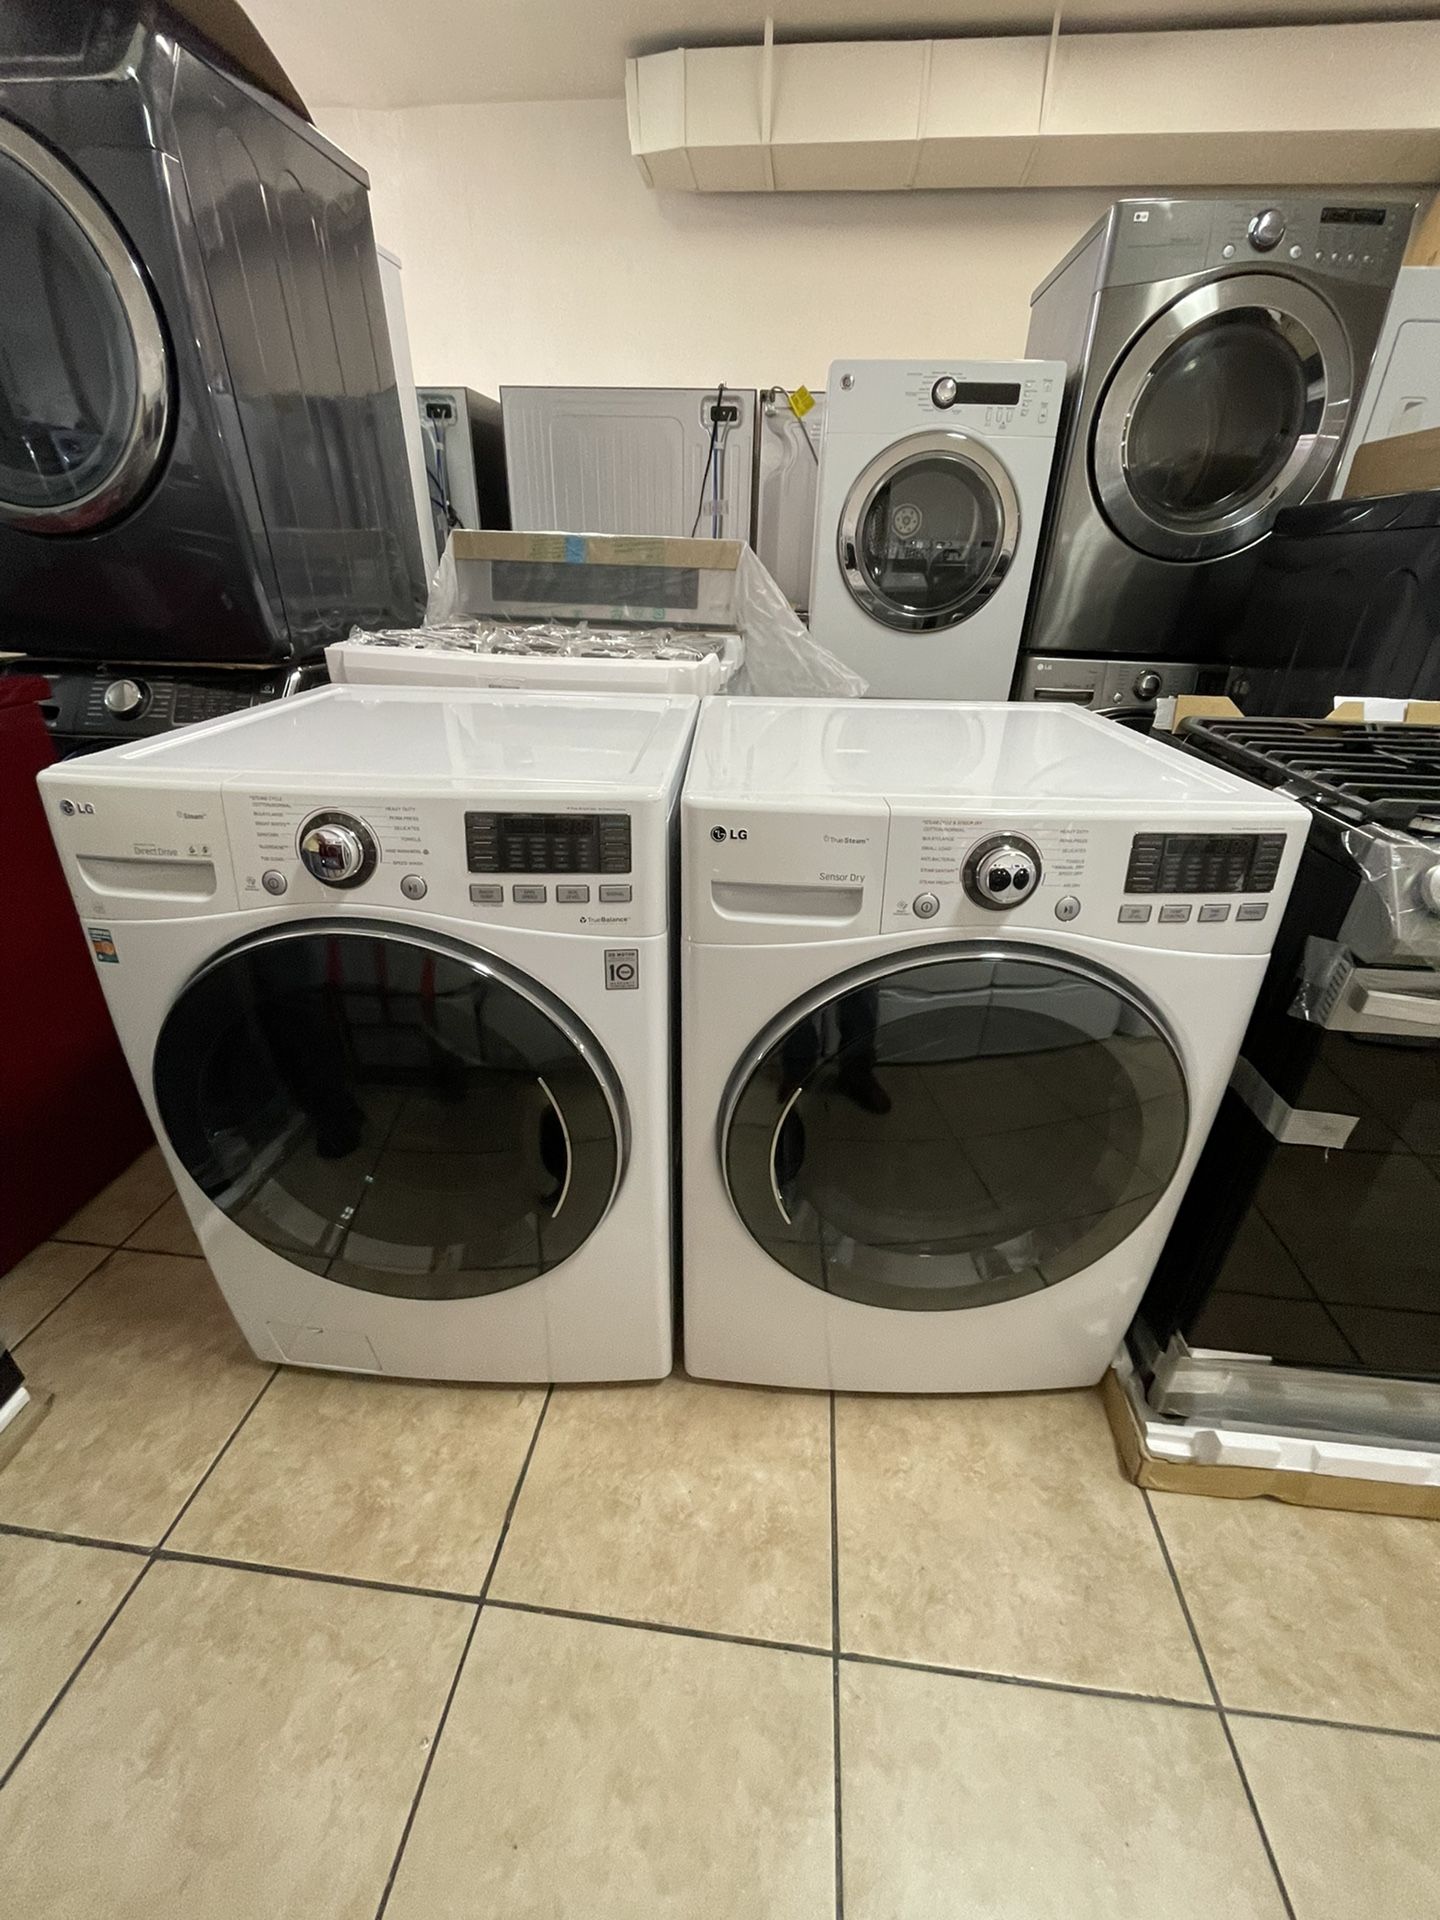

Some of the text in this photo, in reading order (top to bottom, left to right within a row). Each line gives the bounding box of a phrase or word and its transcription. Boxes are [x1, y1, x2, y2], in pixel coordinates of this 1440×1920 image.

[77, 801, 95, 814] LG
[729, 829, 748, 840] LG
[819, 873, 865, 884] Sensor Dry
